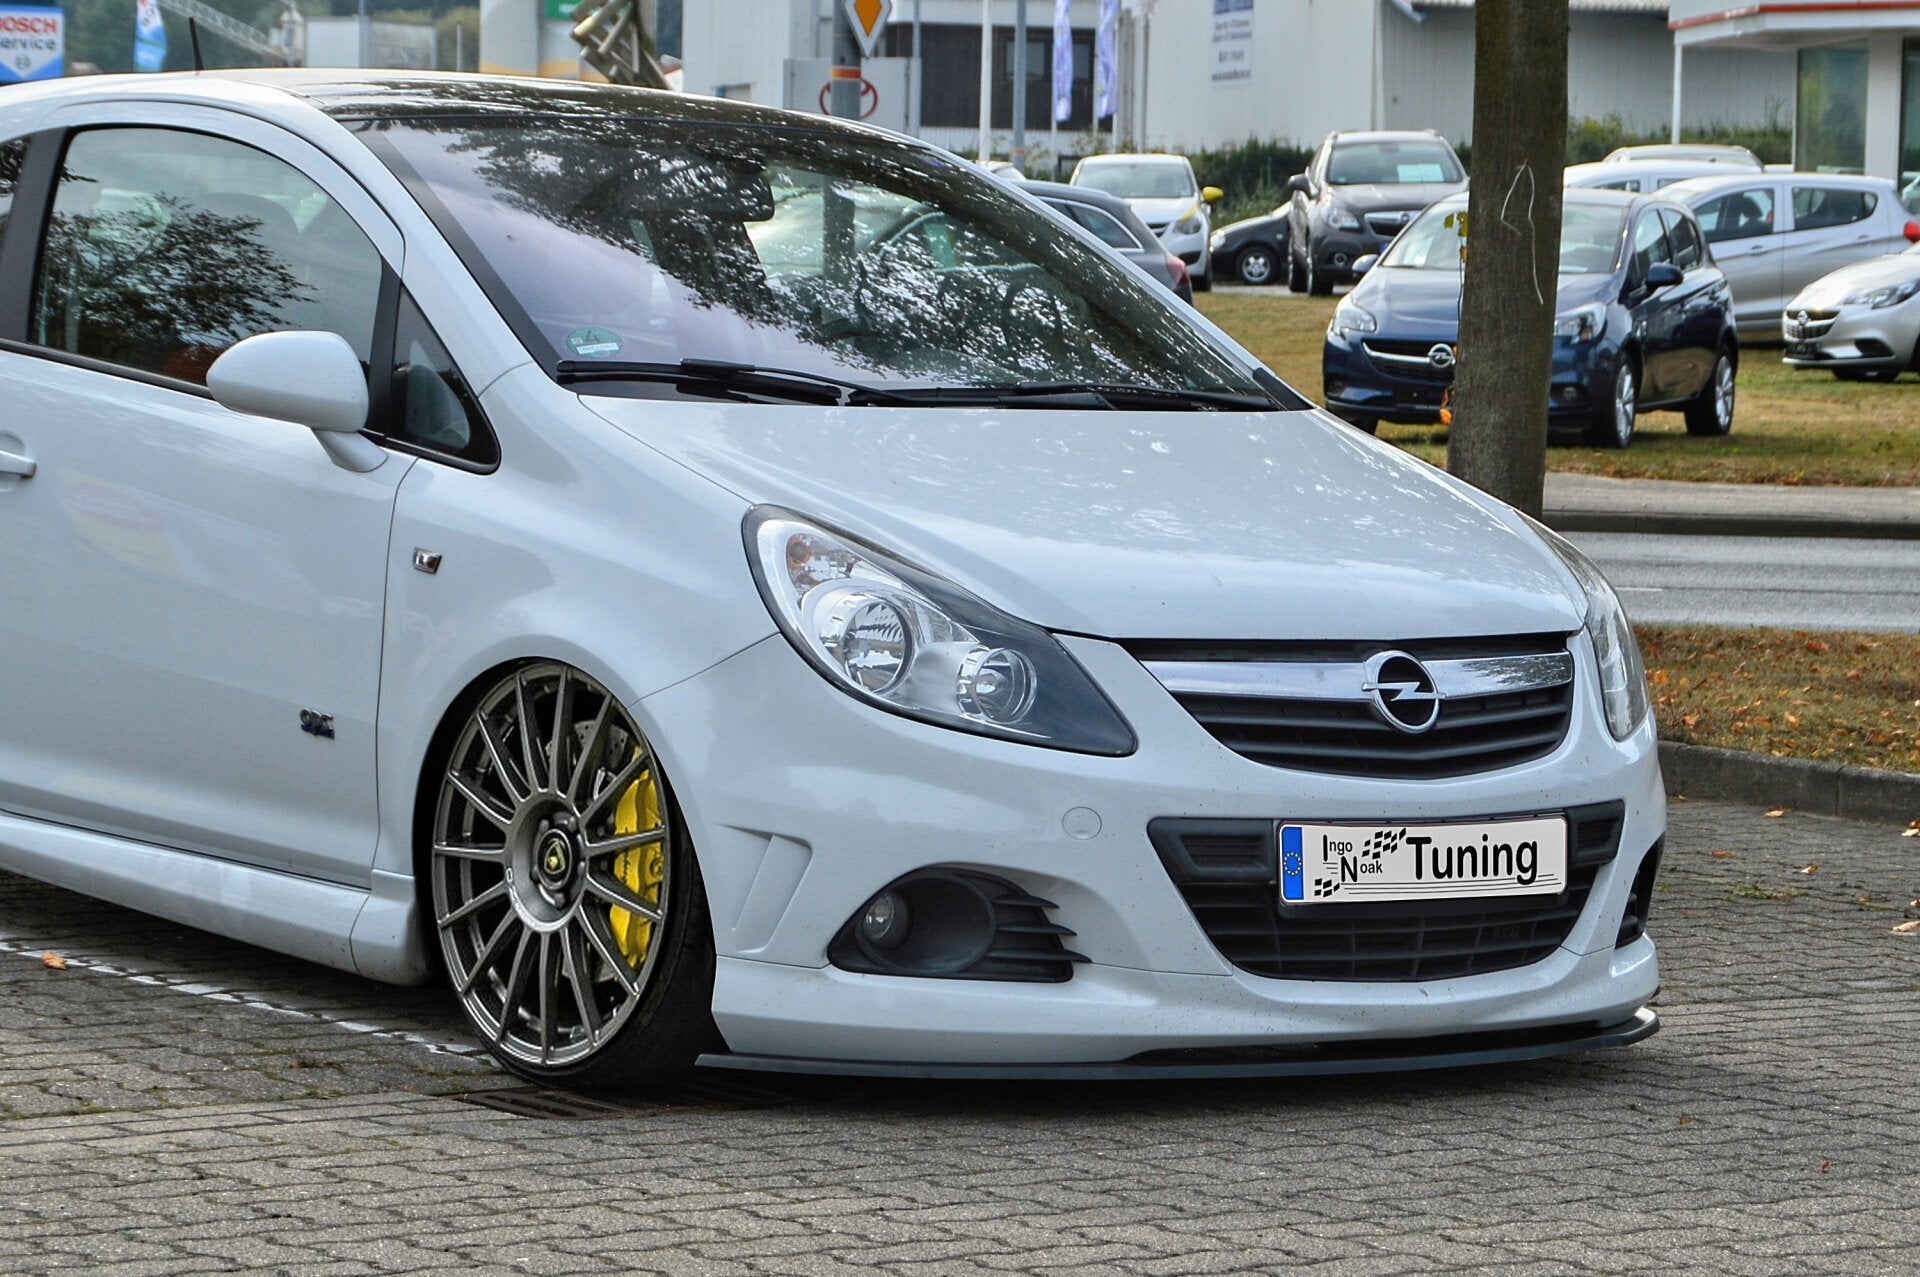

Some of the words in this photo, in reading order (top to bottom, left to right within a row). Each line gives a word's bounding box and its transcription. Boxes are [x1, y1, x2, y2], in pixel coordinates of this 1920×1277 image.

[0, 16, 57, 33] OSCH
[1322, 834, 1353, 861] Ingo
[1405, 833, 1538, 885] Tuning
[1340, 856, 1383, 882] Noak
